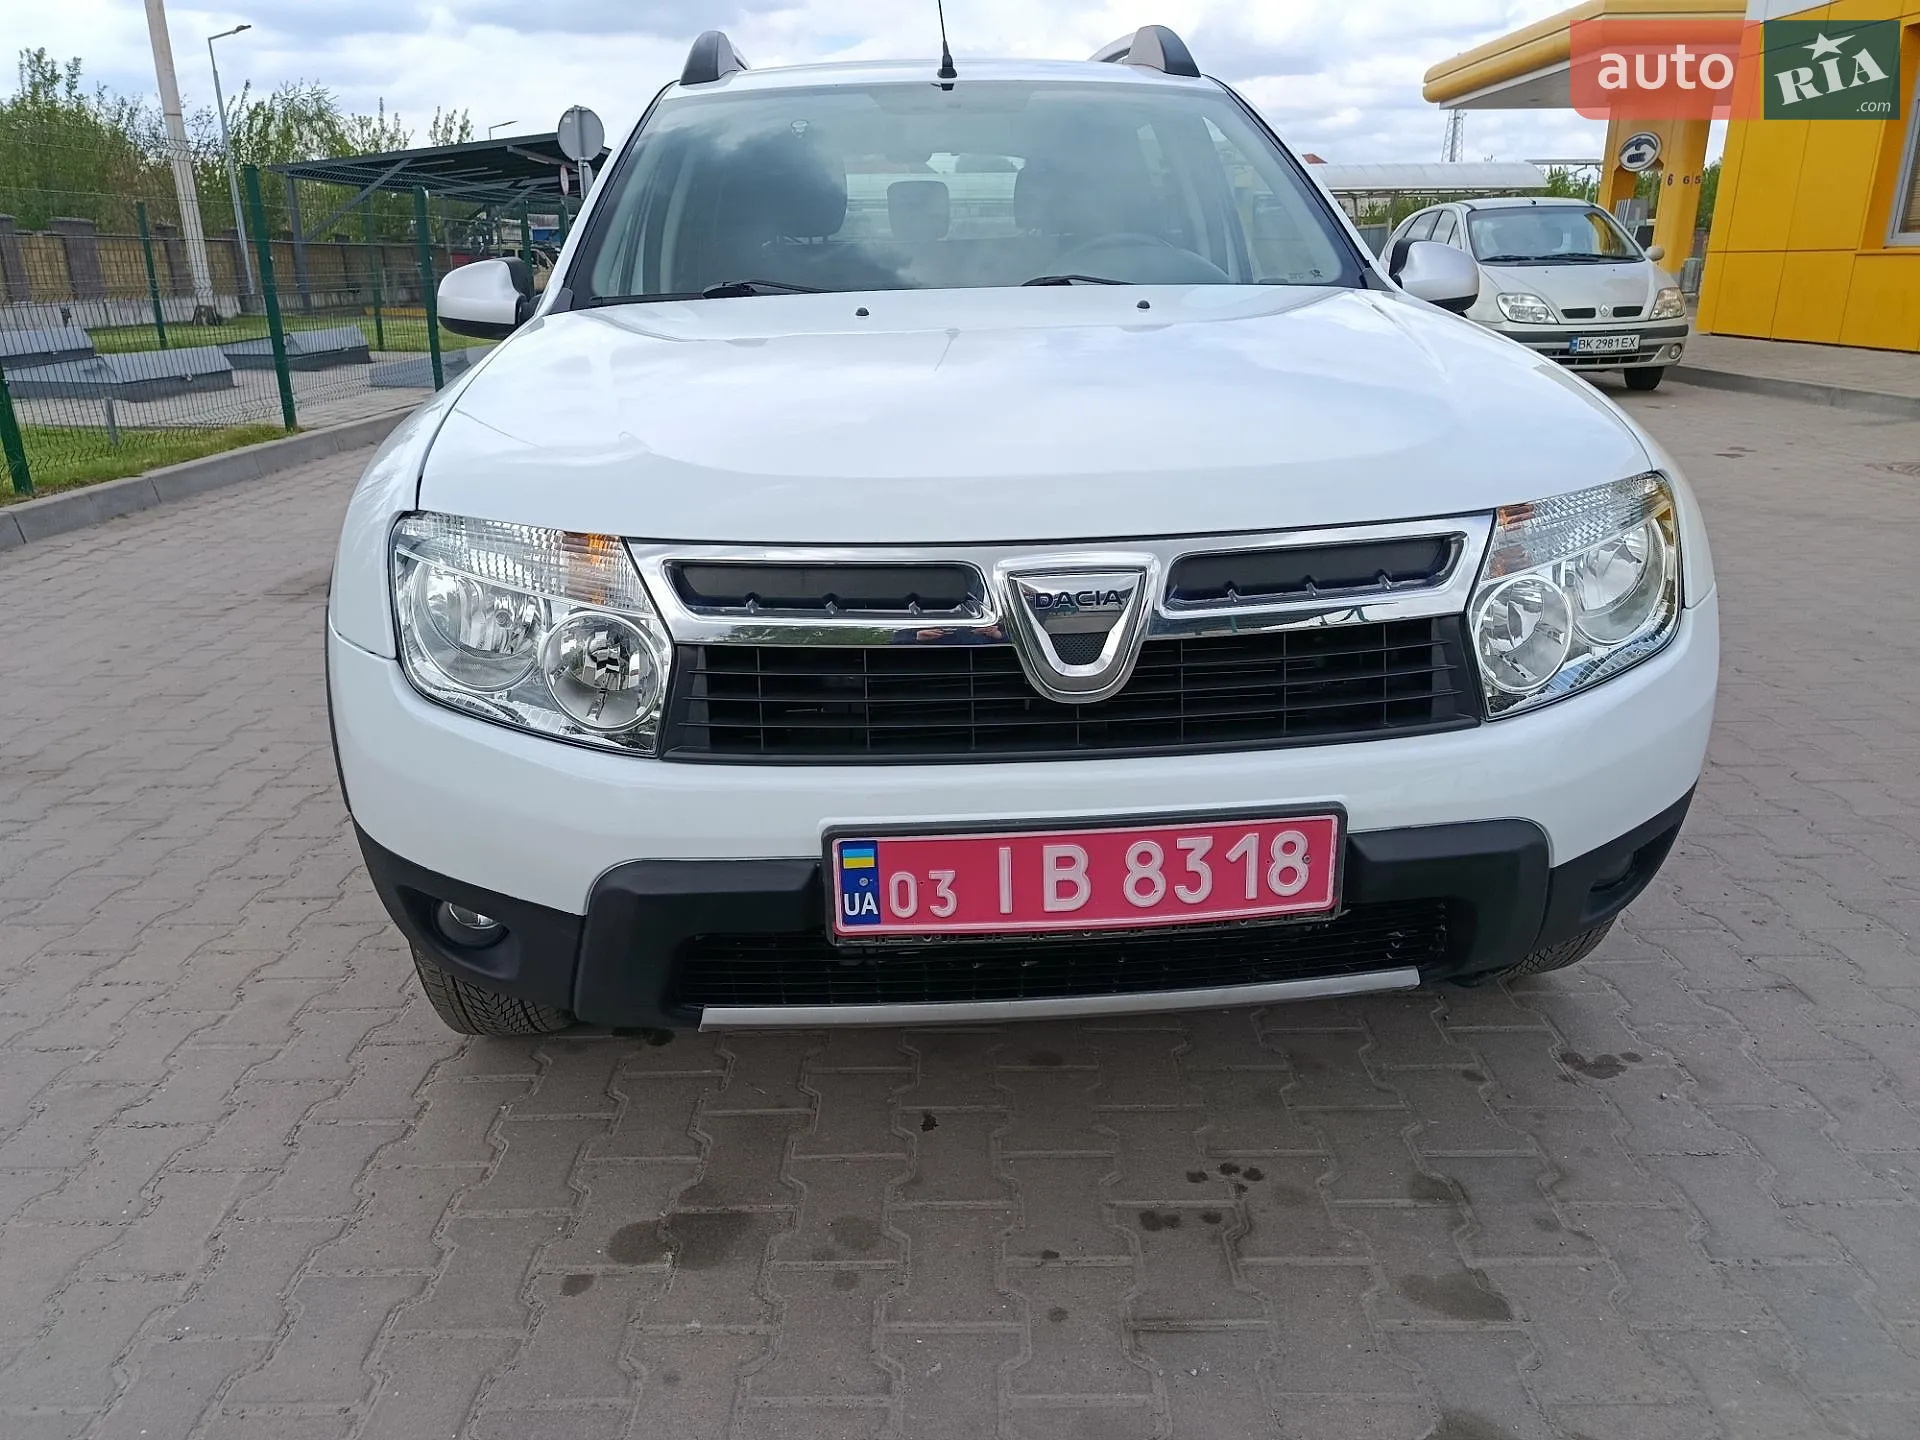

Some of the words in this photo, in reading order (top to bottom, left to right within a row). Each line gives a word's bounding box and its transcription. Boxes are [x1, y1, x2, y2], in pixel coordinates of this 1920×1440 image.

[1578, 339, 1593, 350] BK
[1595, 338, 1620, 350] 2981
[1621, 337, 1636, 349] EX
[1034, 589, 1122, 610] DACIA
[888, 869, 958, 919] 03
[1122, 829, 1311, 908] 8318
[843, 891, 879, 916] UA
